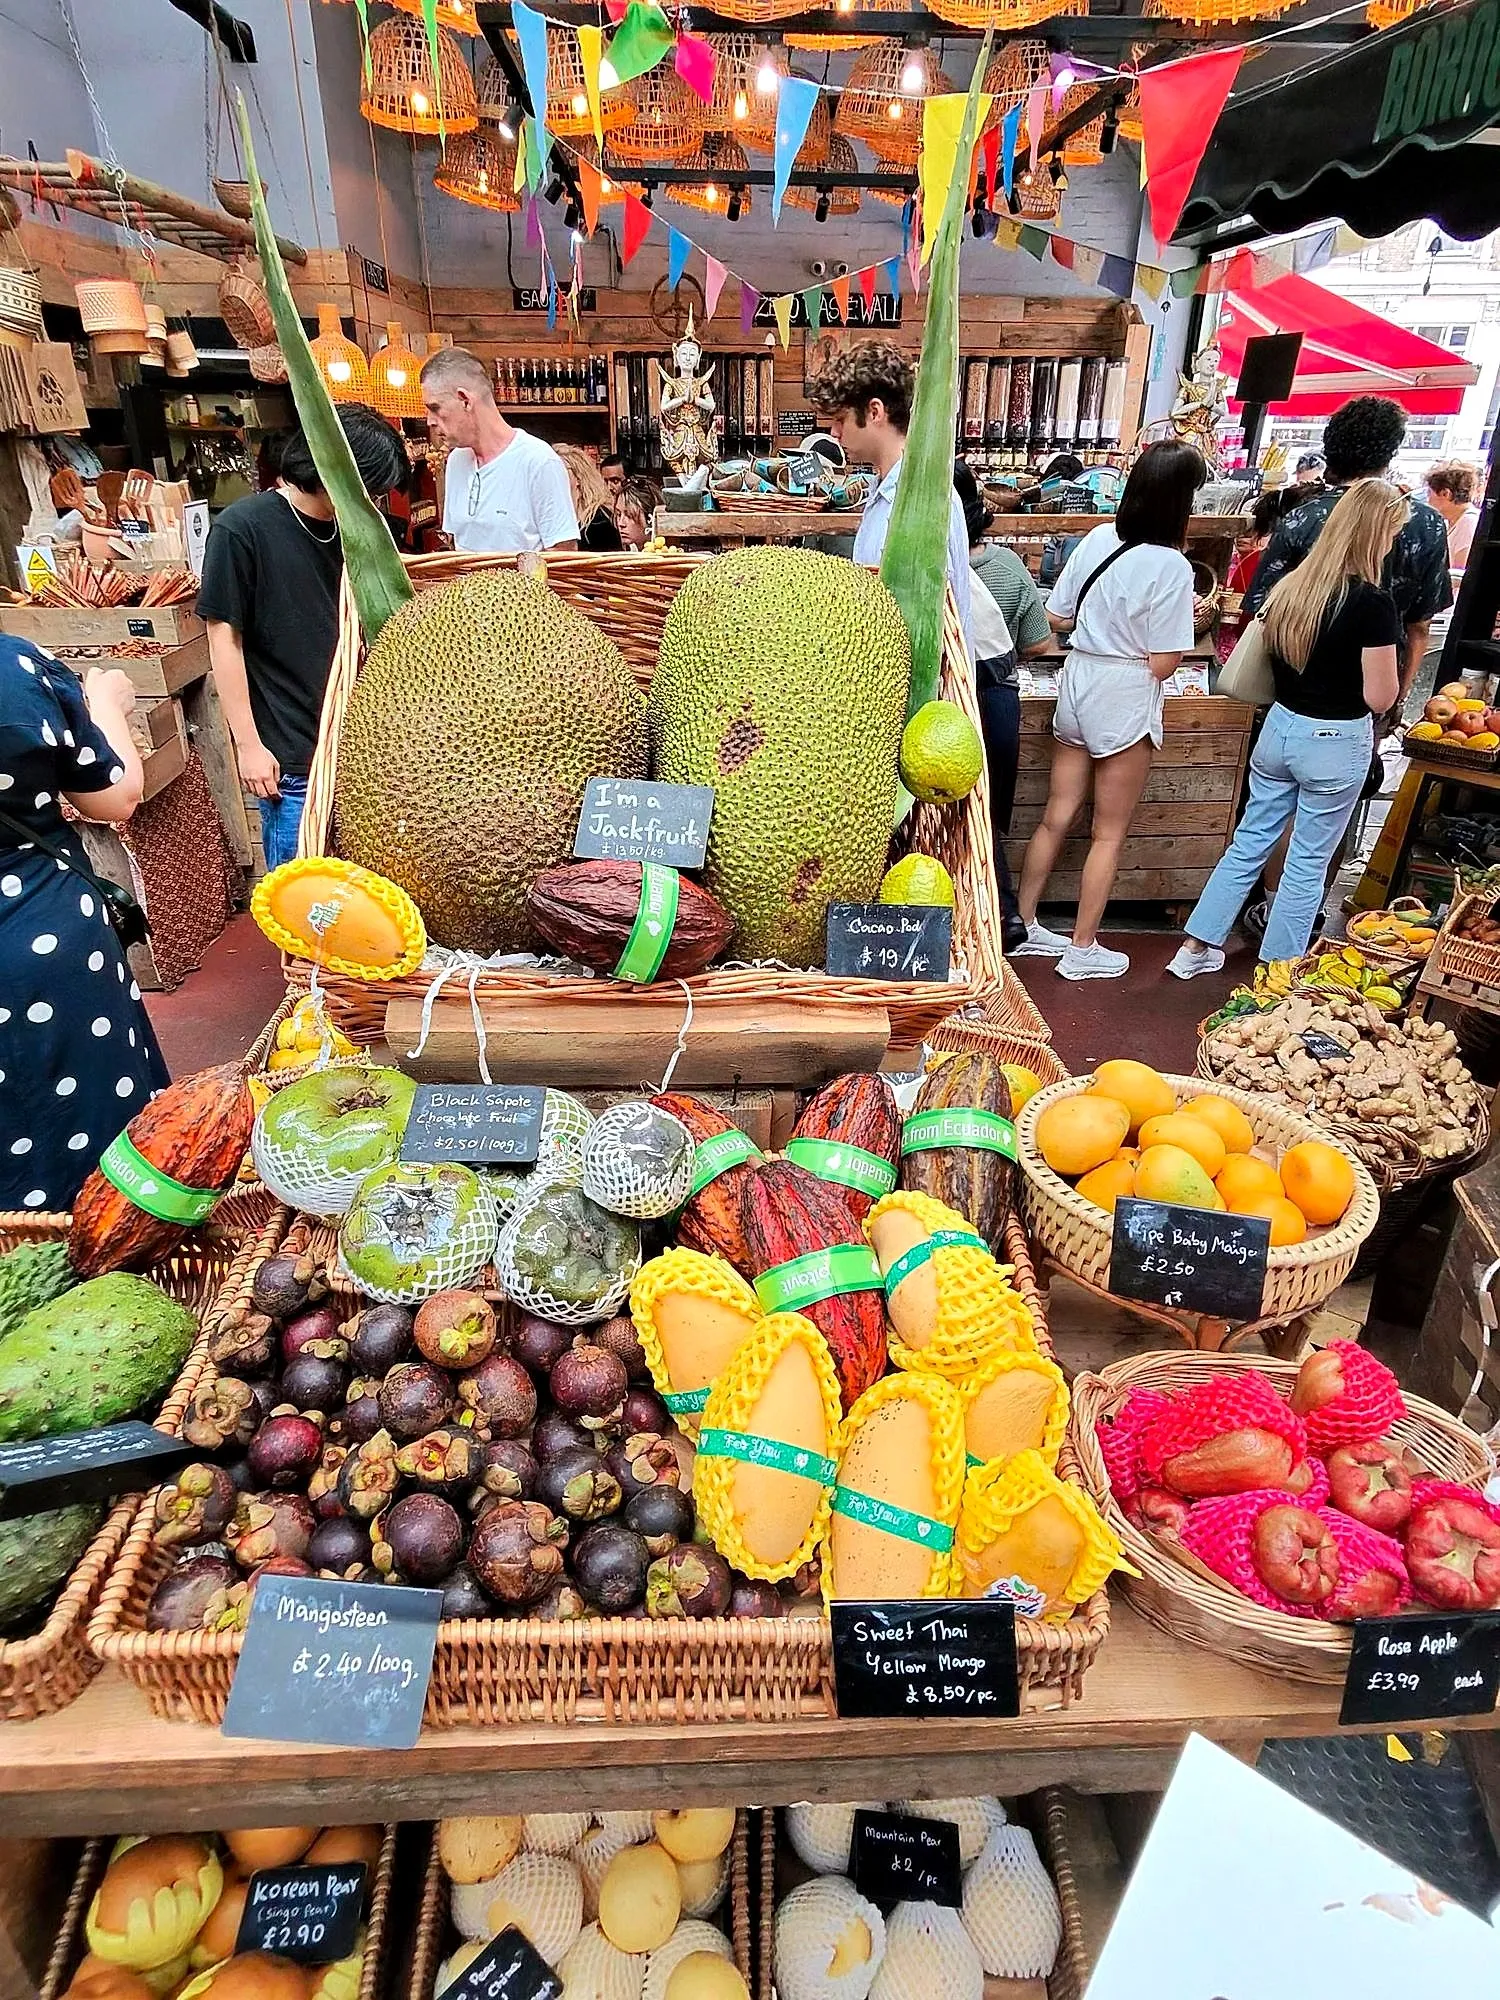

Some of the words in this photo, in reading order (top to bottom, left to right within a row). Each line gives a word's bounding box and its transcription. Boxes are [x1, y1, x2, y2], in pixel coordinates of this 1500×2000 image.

[594, 783, 638, 808] I'm
[646, 796, 661, 809] a
[848, 917, 894, 935] Cacao
[900, 917, 922, 934] Pod
[430, 1093, 481, 1108] Black
[485, 1094, 532, 1110] Sapote
[911, 1124, 939, 1143] from
[943, 1118, 1001, 1142] Ecuador
[1172, 1228, 1208, 1256] Baby
[1140, 1253, 1196, 1276] £2.50
[276, 1595, 389, 1634] Mangosteen
[853, 1621, 915, 1642] Sweet
[922, 1619, 968, 1641] Thai
[1378, 1636, 1412, 1656] Rose
[1418, 1631, 1458, 1655] Apple
[866, 1651, 927, 1675] Yellow
[939, 1654, 986, 1676] Mango
[1366, 1671, 1420, 1691] £3.99
[1453, 1669, 1484, 1690] each
[865, 1826, 915, 1843] Mountain
[920, 1831, 941, 1847] Pear
[891, 1853, 913, 1873] £2
[252, 1881, 319, 1906] Korean
[326, 1874, 360, 1897] Pear
[262, 1923, 325, 1950] £2.90
[469, 1958, 497, 1986] Pear
